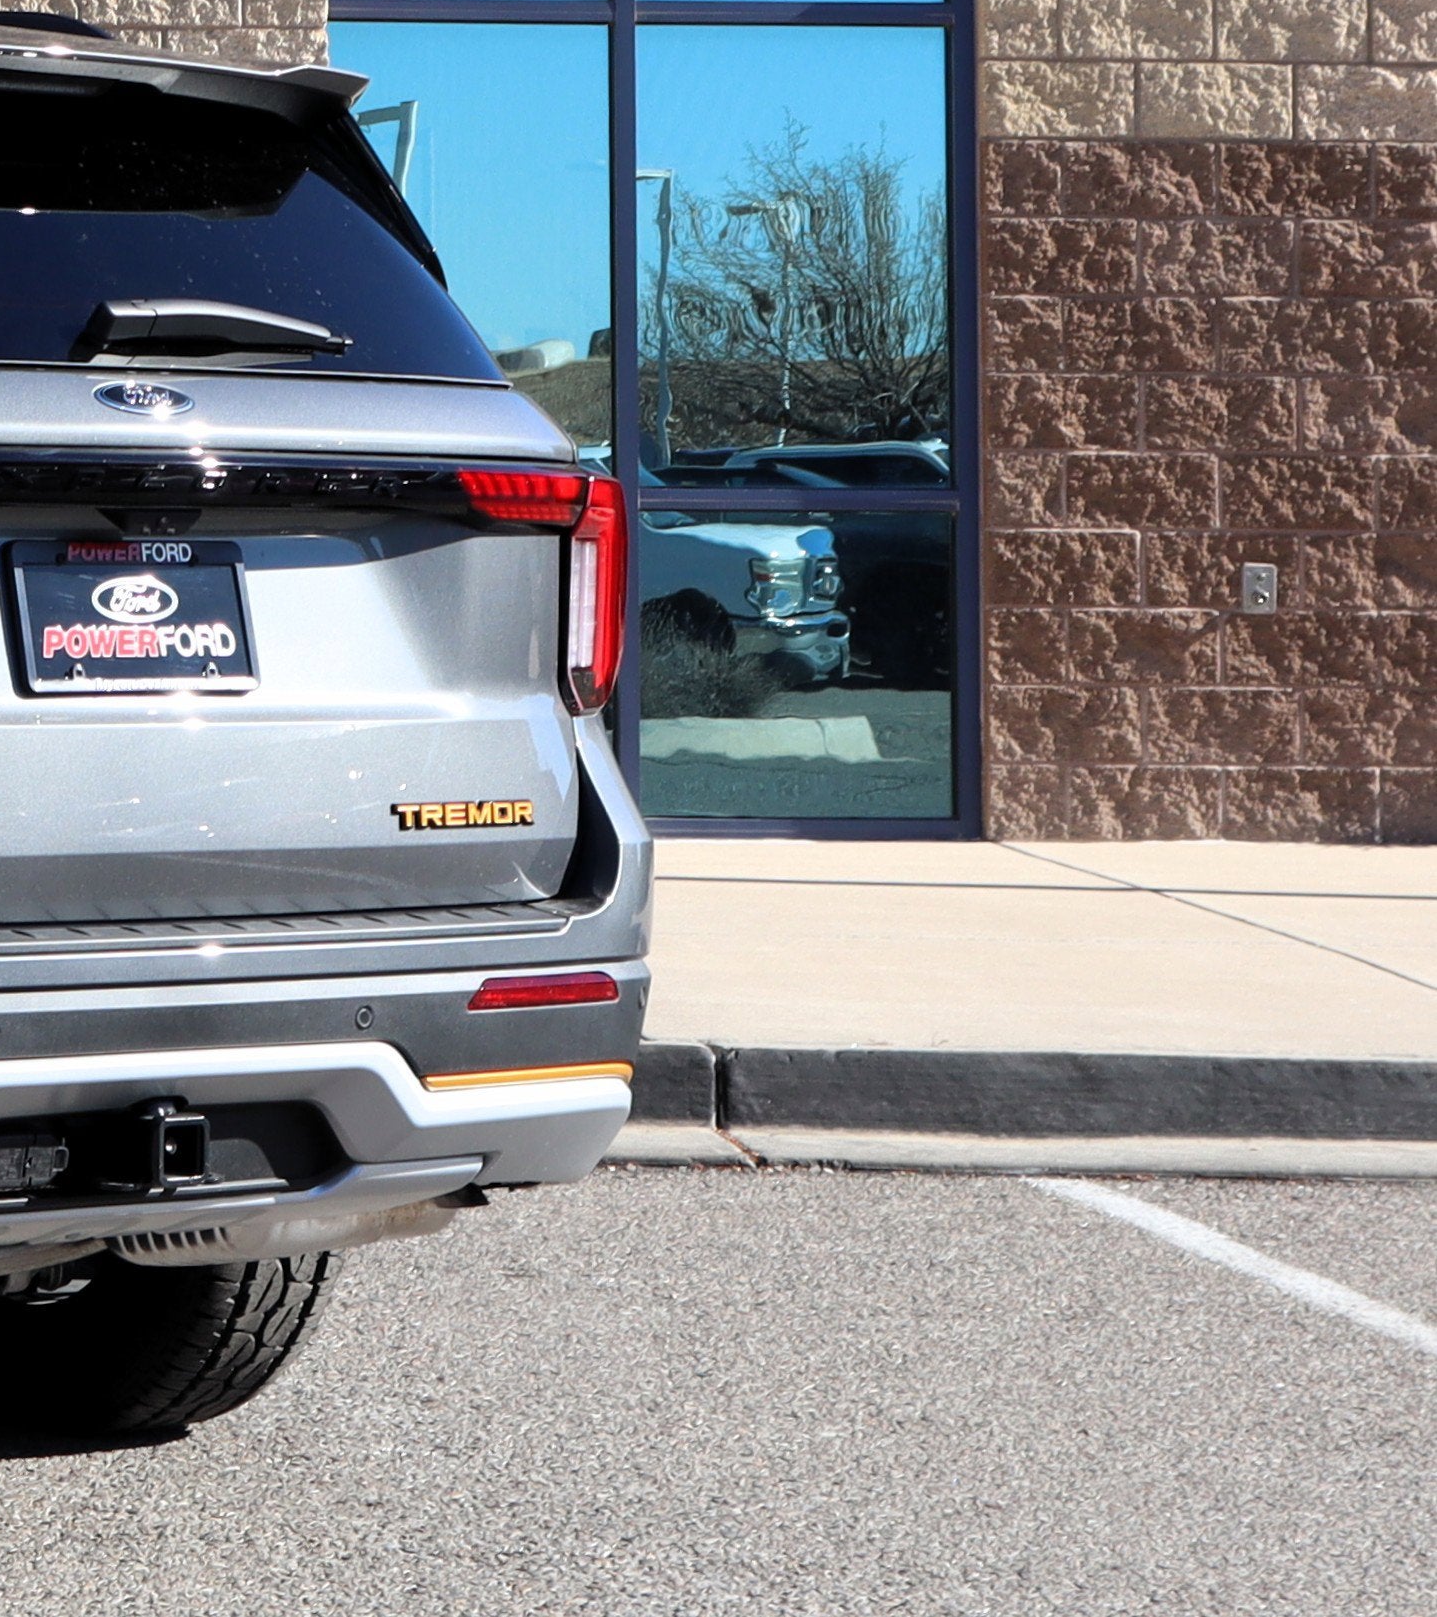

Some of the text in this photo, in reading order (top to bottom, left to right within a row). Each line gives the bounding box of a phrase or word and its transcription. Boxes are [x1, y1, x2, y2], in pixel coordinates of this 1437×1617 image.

[123, 382, 173, 407] Ford
[66, 542, 193, 563] POWERFORD
[109, 584, 162, 614] Ford
[42, 622, 237, 659] POWERFORD
[391, 798, 534, 830] TREMOR
